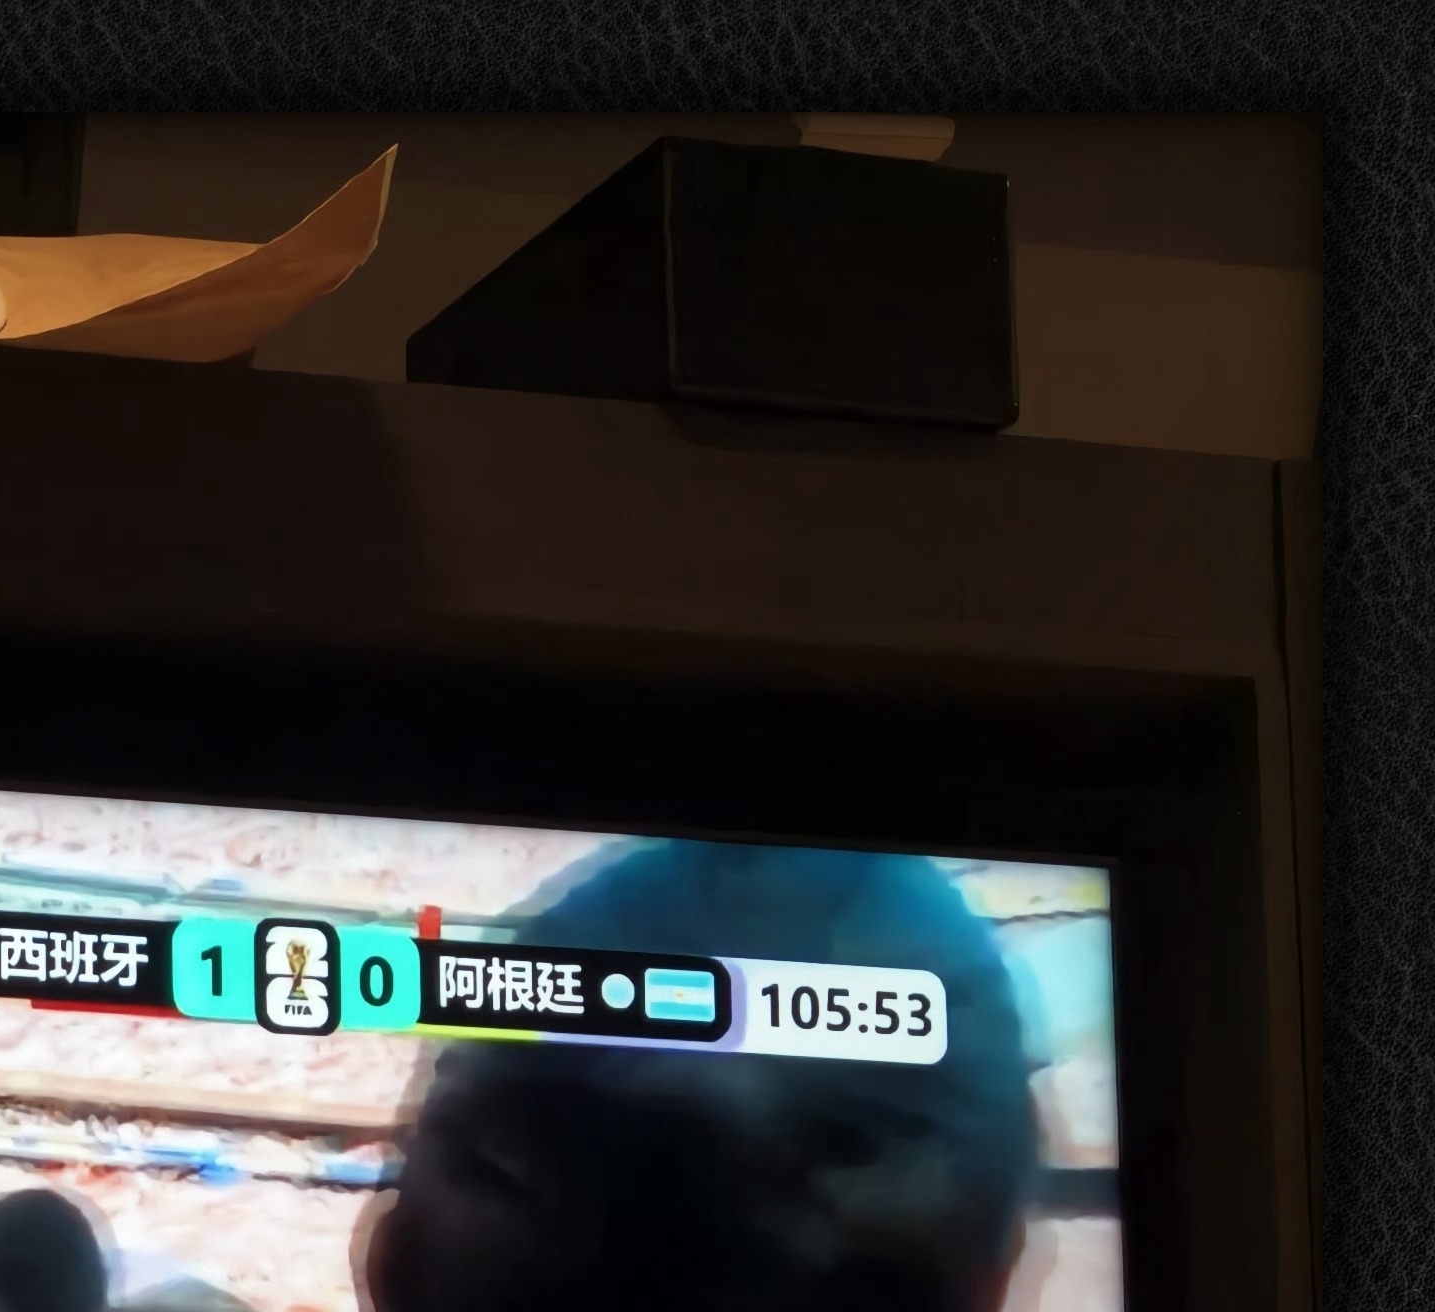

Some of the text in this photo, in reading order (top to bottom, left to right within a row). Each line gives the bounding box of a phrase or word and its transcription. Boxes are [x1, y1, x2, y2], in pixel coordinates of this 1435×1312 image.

[201, 946, 222, 996] 1
[360, 956, 394, 1006] 0
[438, 955, 585, 1016] 阿根廷
[284, 1004, 312, 1016] FIFA
[761, 983, 932, 1037] 105:53
